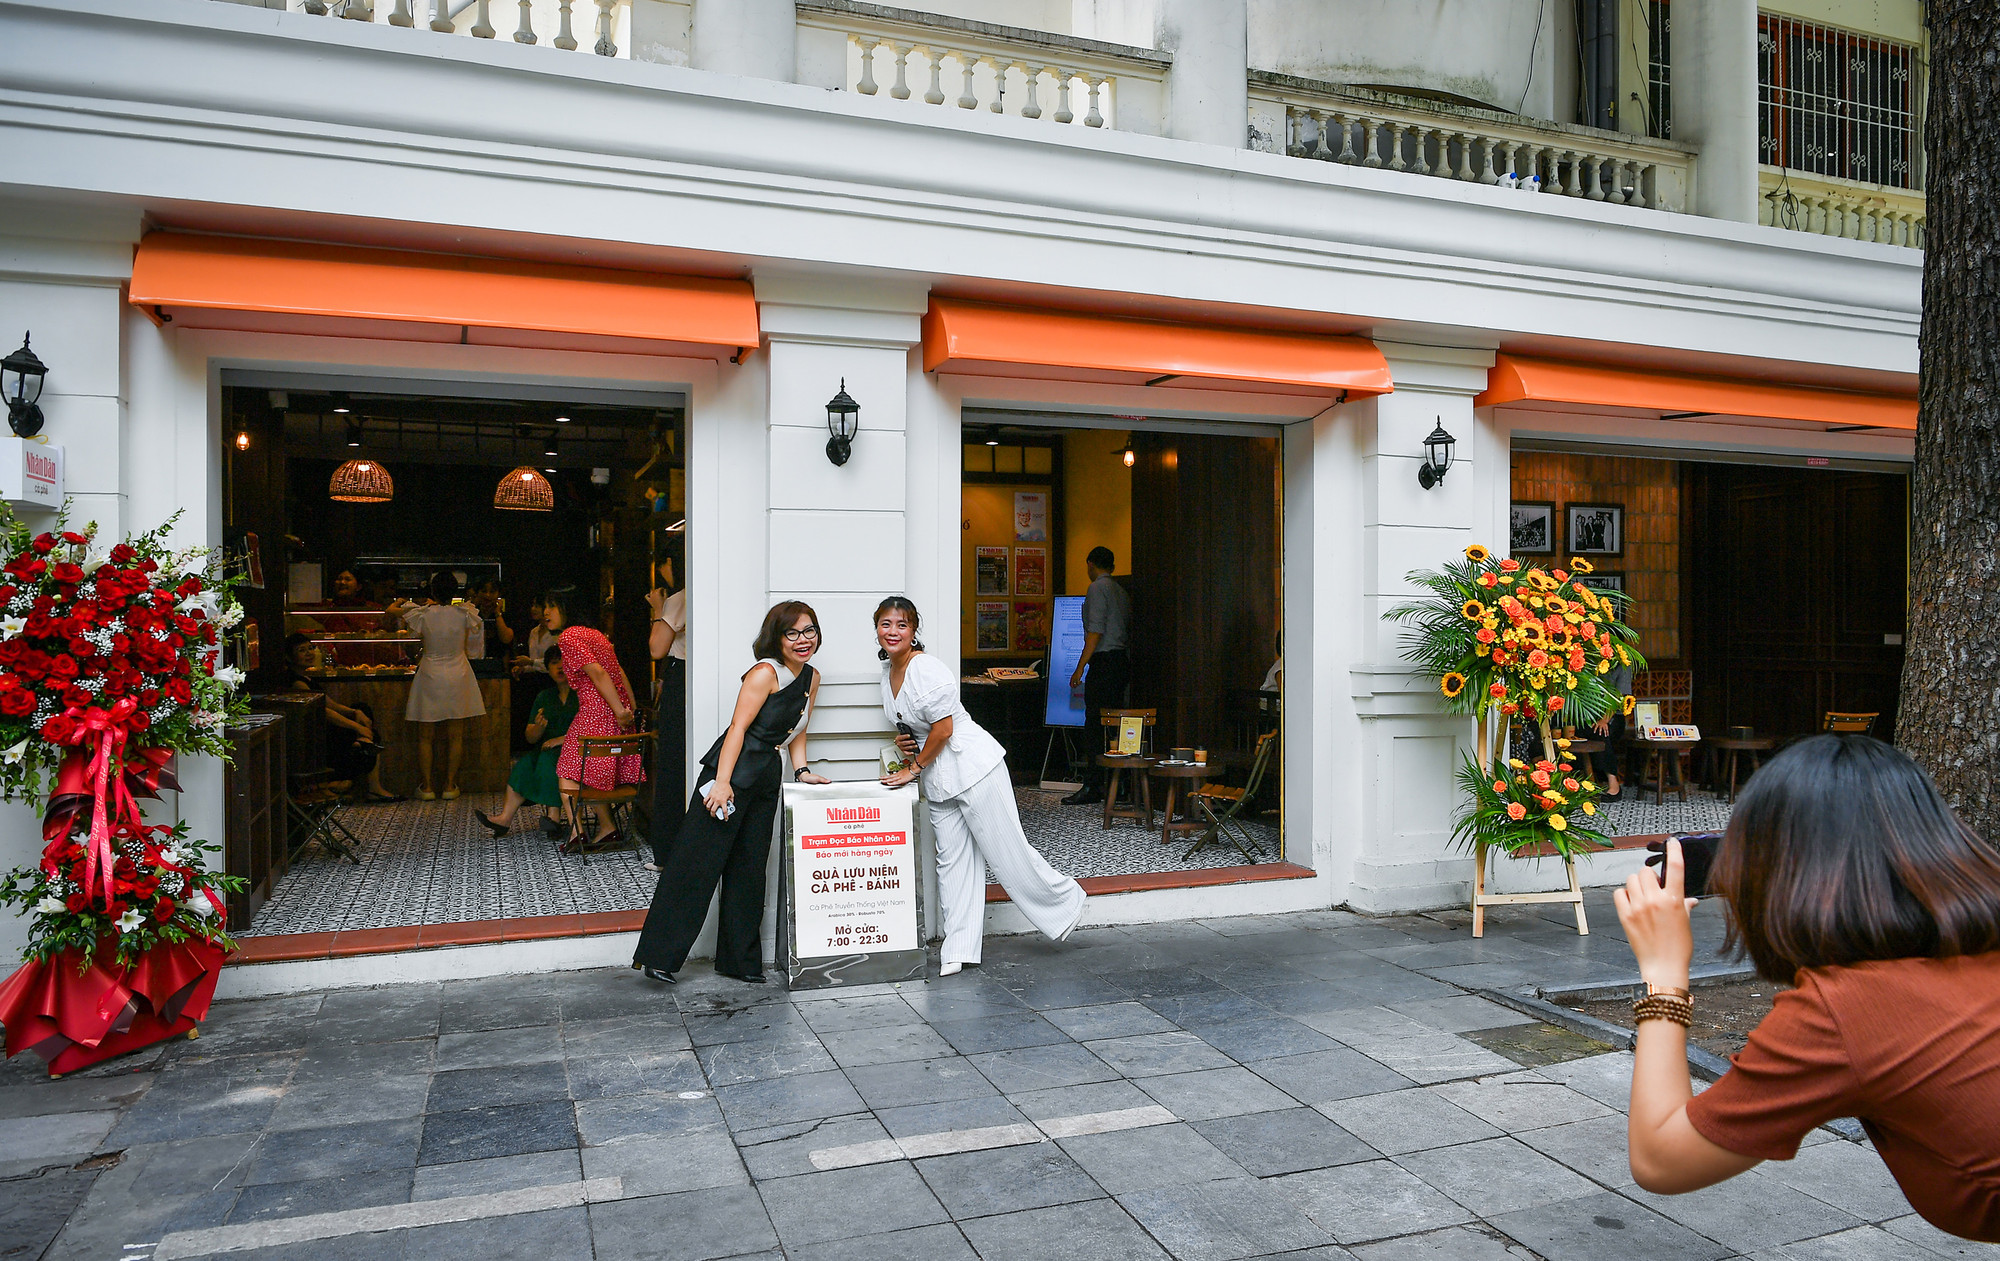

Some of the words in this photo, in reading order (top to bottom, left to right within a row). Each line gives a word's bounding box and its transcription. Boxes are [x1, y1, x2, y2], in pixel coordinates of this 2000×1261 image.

[26, 451, 43, 476] Nhân
[43, 456, 56, 479] Dân
[826, 807, 857, 821] Nhân
[857, 806, 881, 820] Dân
[808, 838, 828, 847] Trạm
[829, 837, 845, 846] Đọc
[846, 836, 861, 844] Báo
[863, 835, 883, 843] Nhân
[885, 834, 900, 842] Dân
[815, 850, 832, 859] Báo
[833, 849, 849, 858] mới
[850, 849, 872, 858] hàng
[873, 848, 894, 857] ngày
[812, 866, 840, 880] QUÀ
[843, 867, 865, 879] LƯU
[869, 864, 898, 879] NIỆM
[811, 880, 830, 894] CÀ
[833, 879, 856, 893] PHÊ
[866, 877, 900, 891] BÁNH
[834, 901, 855, 911] Truyền
[856, 900, 876, 909] Thống
[876, 899, 889, 908] Việt
[835, 924, 852, 935] Mở
[855, 922, 879, 934] cửa:
[827, 937, 850, 948] 7:00
[859, 934, 888, 945] 22:30
